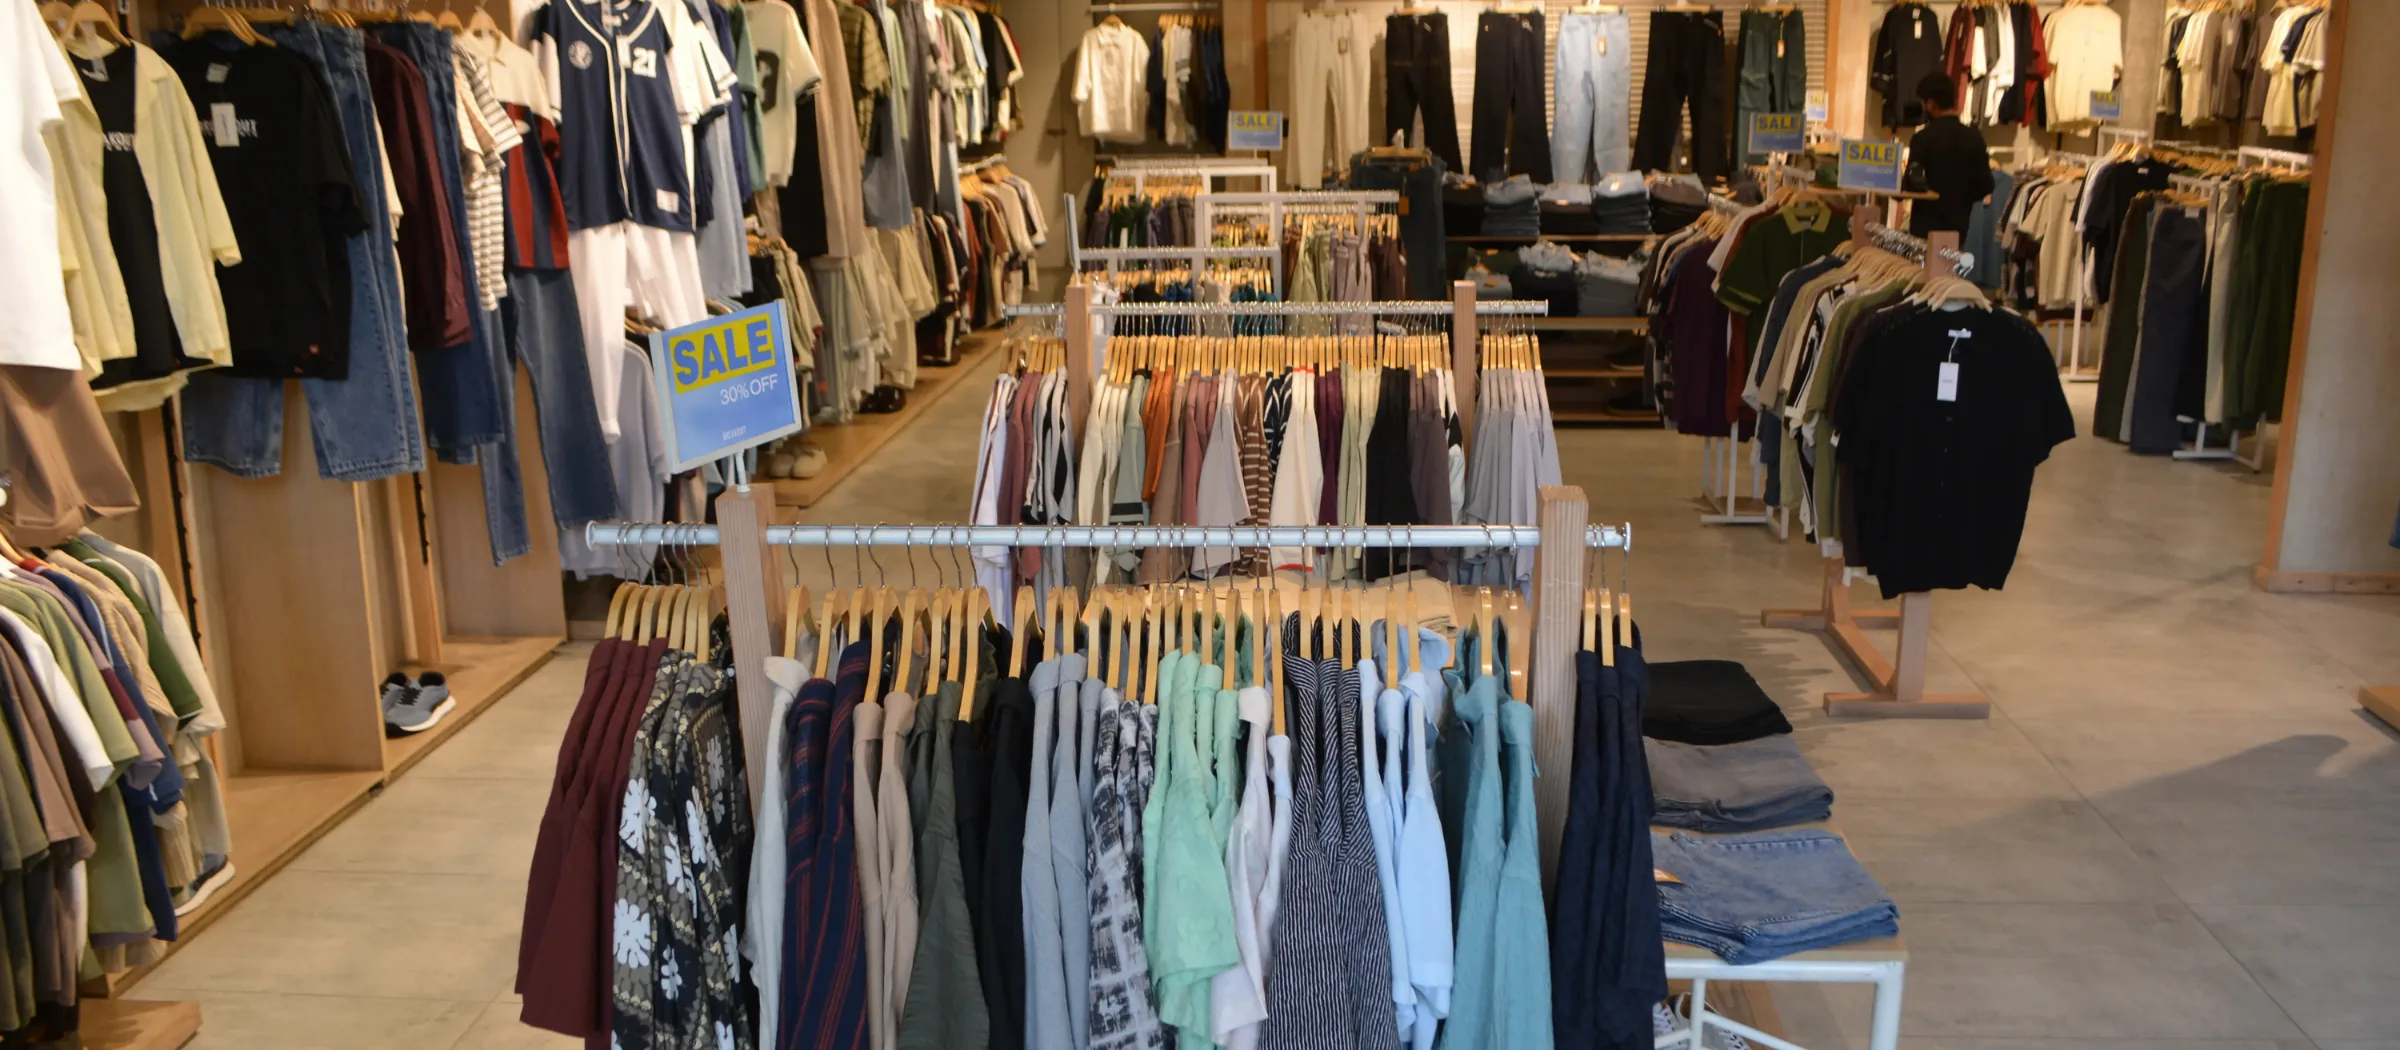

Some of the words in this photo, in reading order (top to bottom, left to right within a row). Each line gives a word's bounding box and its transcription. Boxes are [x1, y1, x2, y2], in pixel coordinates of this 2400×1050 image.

[632, 47, 657, 78] 21
[1236, 114, 1274, 127] SALE
[1759, 115, 1800, 129] SALE
[1850, 144, 1894, 163] SALE
[673, 319, 772, 385] SALE
[720, 382, 750, 405] 30%
[750, 373, 778, 395] OFF
